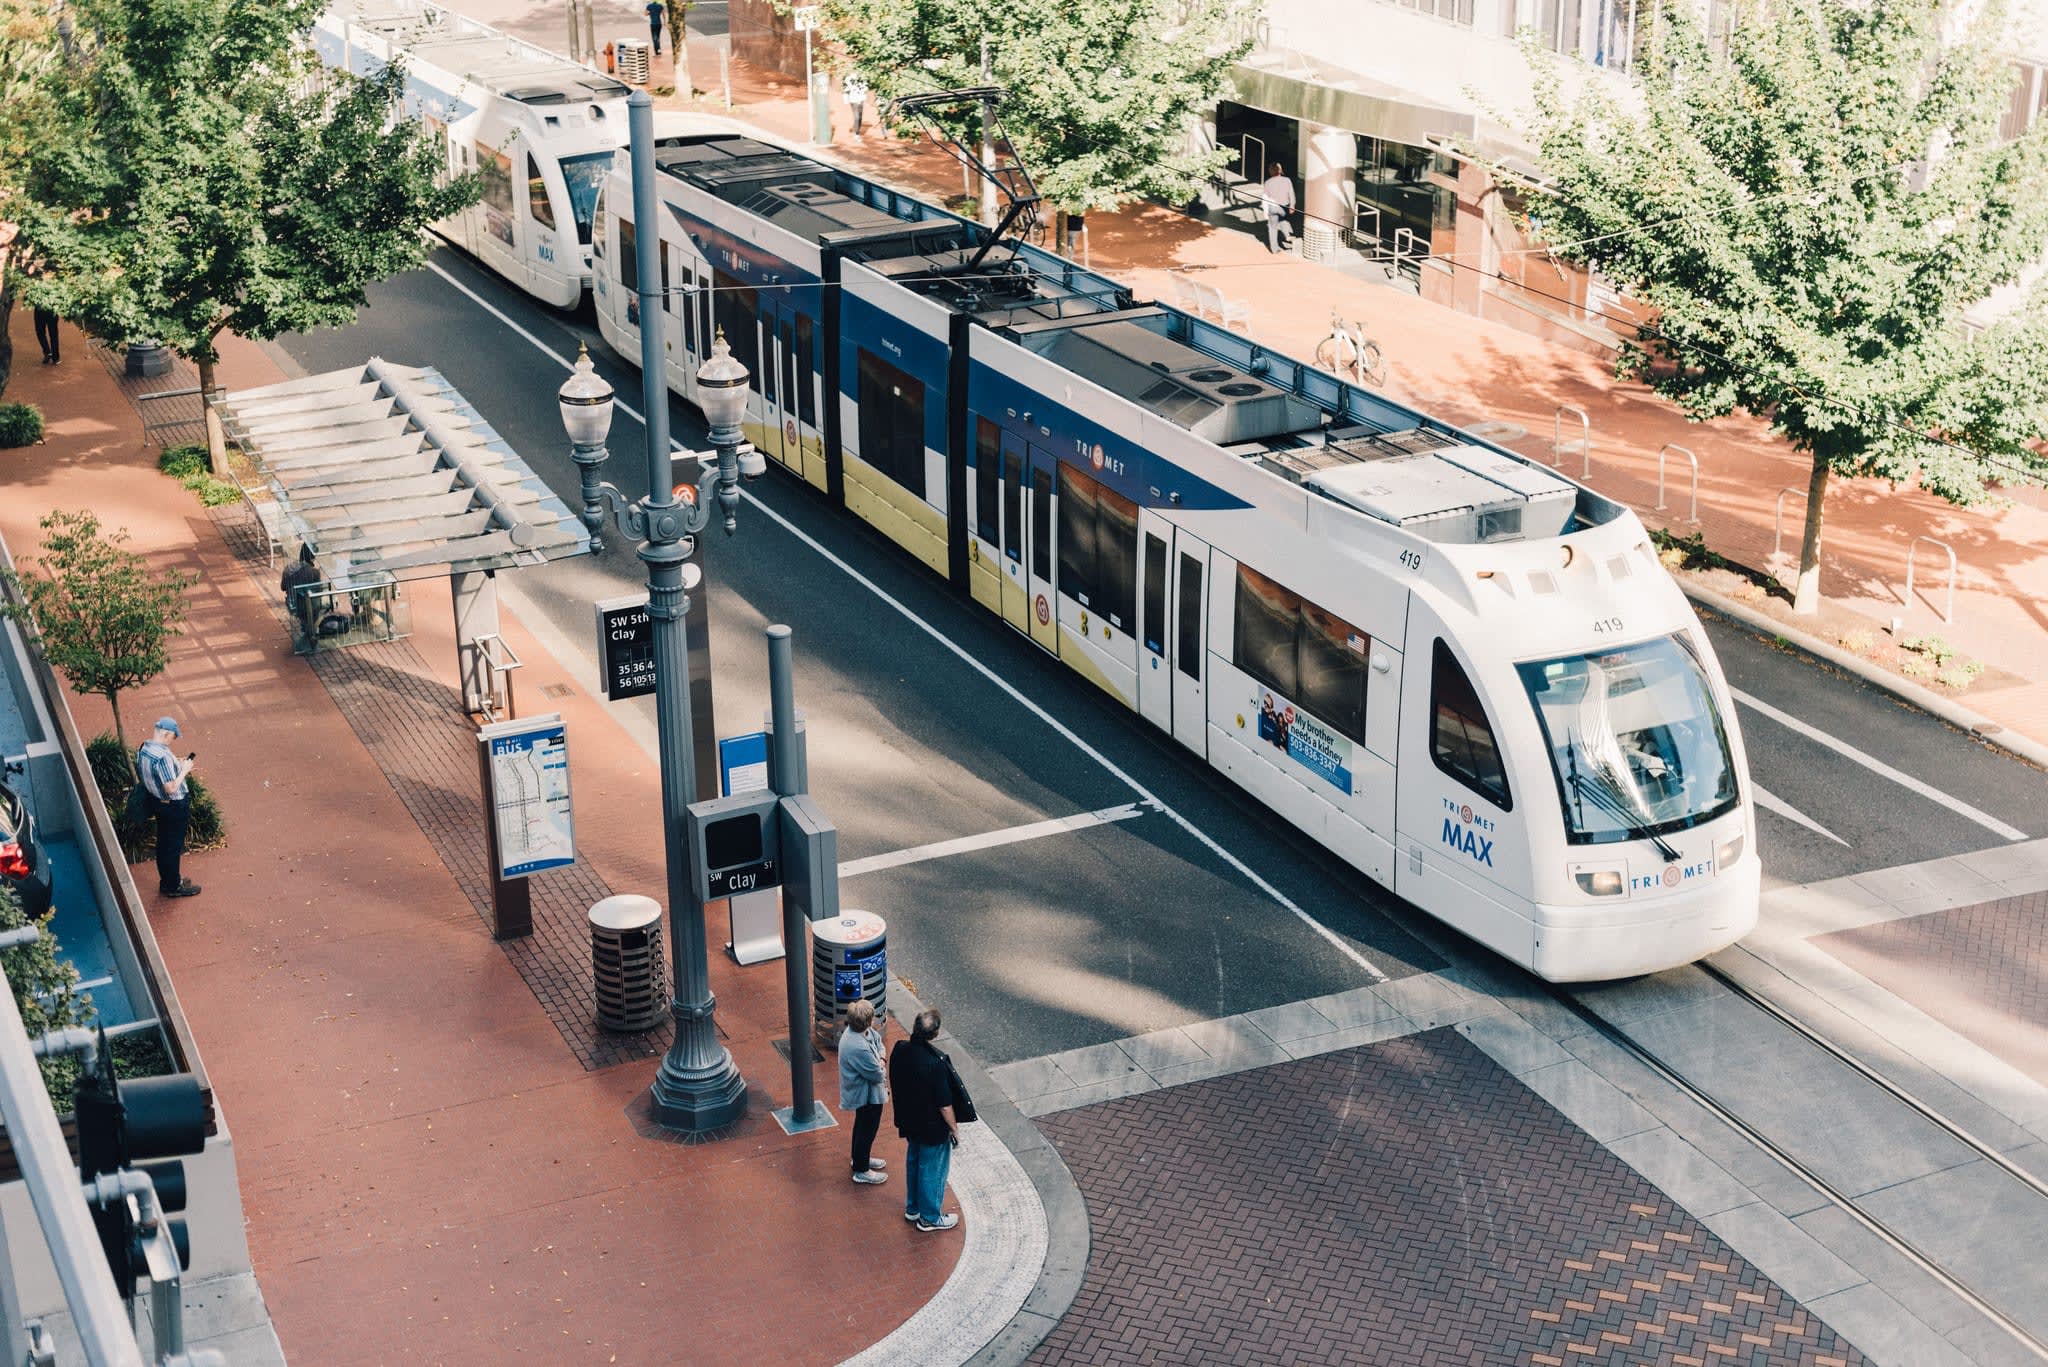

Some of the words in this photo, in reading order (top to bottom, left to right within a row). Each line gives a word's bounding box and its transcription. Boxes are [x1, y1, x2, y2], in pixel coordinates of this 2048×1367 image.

[1399, 549, 1421, 570] 419
[610, 616, 628, 628] SW
[630, 612, 649, 625] 5th
[1594, 617, 1623, 633] 419
[611, 629, 636, 641] Clay
[618, 664, 631, 675] 35
[632, 662, 645, 673] 36
[647, 660, 656, 670] 4
[619, 677, 632, 688] 56
[633, 674, 647, 684] 105
[1295, 713, 1306, 730] My
[1307, 720, 1334, 745] brother
[497, 743, 522, 755] BUS
[1290, 726, 1312, 745] needs
[1318, 740, 1343, 767] kidney
[1442, 817, 1493, 868] MAX
[710, 872, 722, 882] SW
[729, 873, 756, 890] Clay
[764, 860, 773, 870] ST
